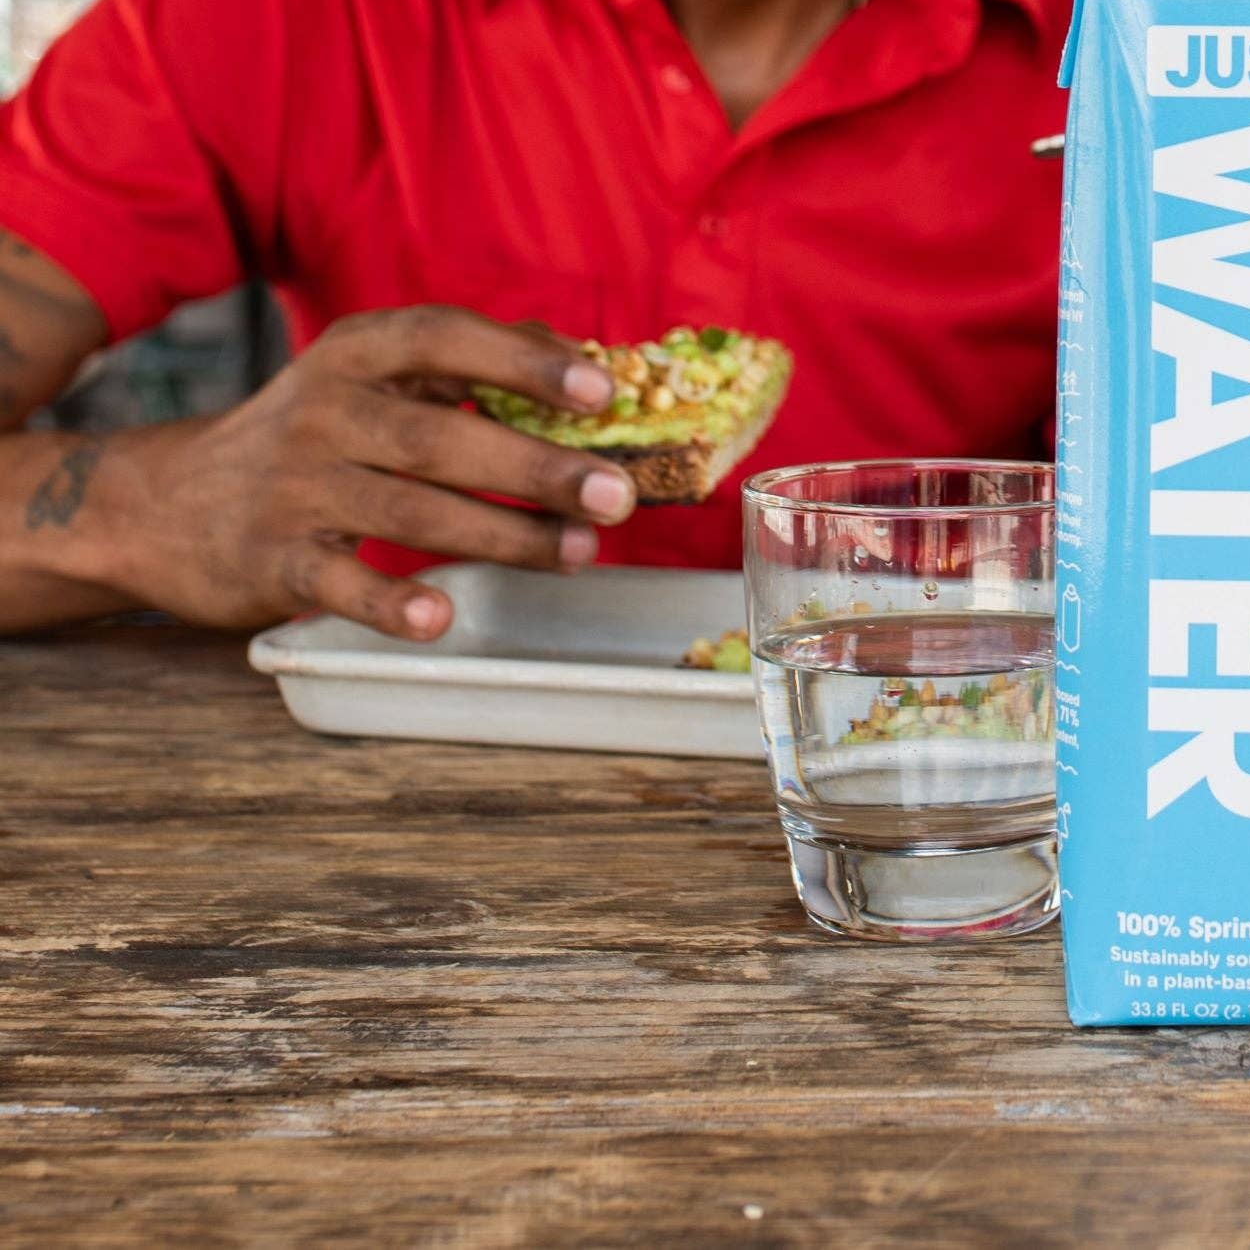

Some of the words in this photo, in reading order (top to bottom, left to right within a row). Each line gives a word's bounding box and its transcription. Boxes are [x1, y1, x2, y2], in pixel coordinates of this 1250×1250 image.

[1060, 705, 1080, 727] 71%
[1118, 912, 1180, 937] 100%
[1111, 947, 1219, 968] Sustainably
[1124, 970, 1141, 986] in
[1148, 976, 1157, 986] a
[1131, 1002, 1166, 1017] 33.8
[1172, 1003, 1189, 1018] FL
[1194, 1004, 1218, 1018] OZ
